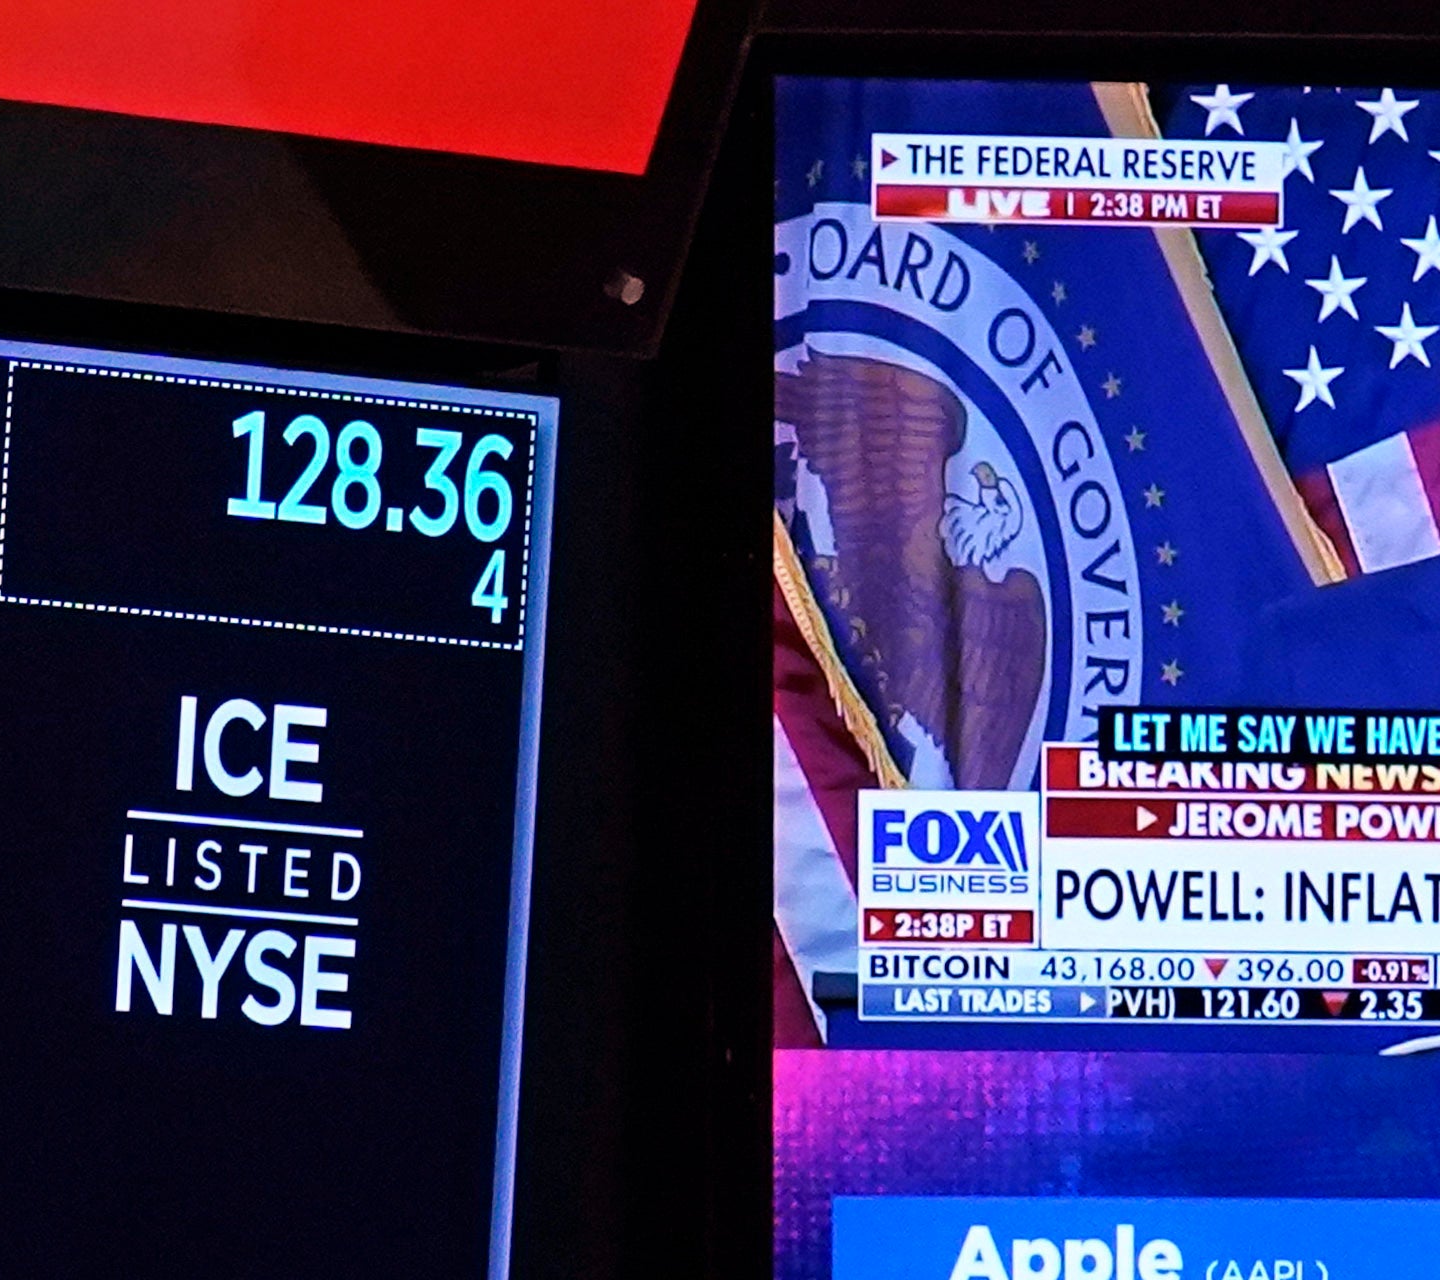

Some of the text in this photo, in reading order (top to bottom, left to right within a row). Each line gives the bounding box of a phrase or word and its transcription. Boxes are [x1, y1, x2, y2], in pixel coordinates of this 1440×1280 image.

[908, 144, 1256, 181] THE FEDERAL RESERVE
[948, 189, 1221, 219] LIVE 2:38 PM ET
[226, 411, 514, 542] 128.36
[471, 550, 508, 623] 4
[176, 695, 327, 802] ICE
[122, 834, 361, 902] LISTED
[873, 810, 1028, 871] FOX
[873, 873, 1028, 894] BUSINESS
[1057, 869, 1264, 922] POWELL:
[115, 920, 355, 1029] NYSE
[871, 955, 1010, 980] BITCOIN
[1041, 956, 1194, 984] 43,168.00
[1238, 959, 1344, 984] 396.00
